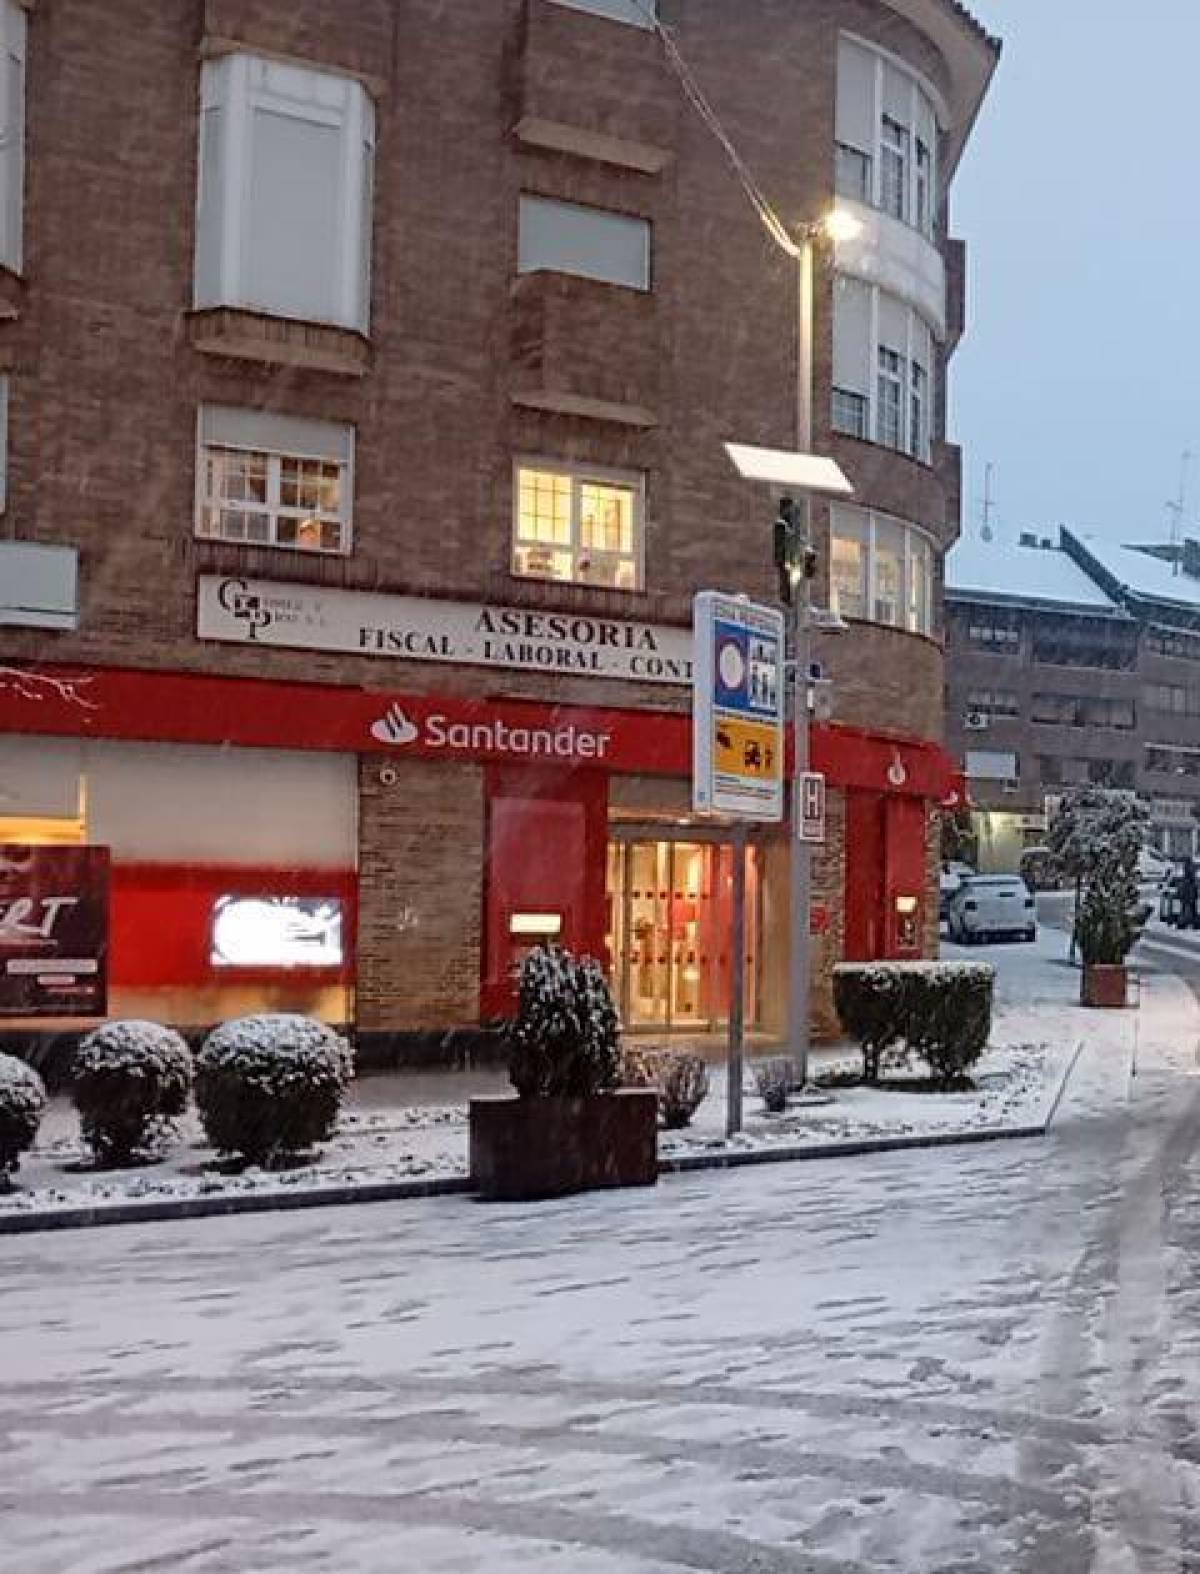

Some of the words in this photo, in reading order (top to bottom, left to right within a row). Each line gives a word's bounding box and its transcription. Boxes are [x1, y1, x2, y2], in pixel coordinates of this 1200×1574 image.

[359, 627, 456, 655] FISCAL
[484, 641, 602, 669] LABORAL
[475, 608, 658, 651] ASESORIA
[425, 713, 611, 758] Santander
